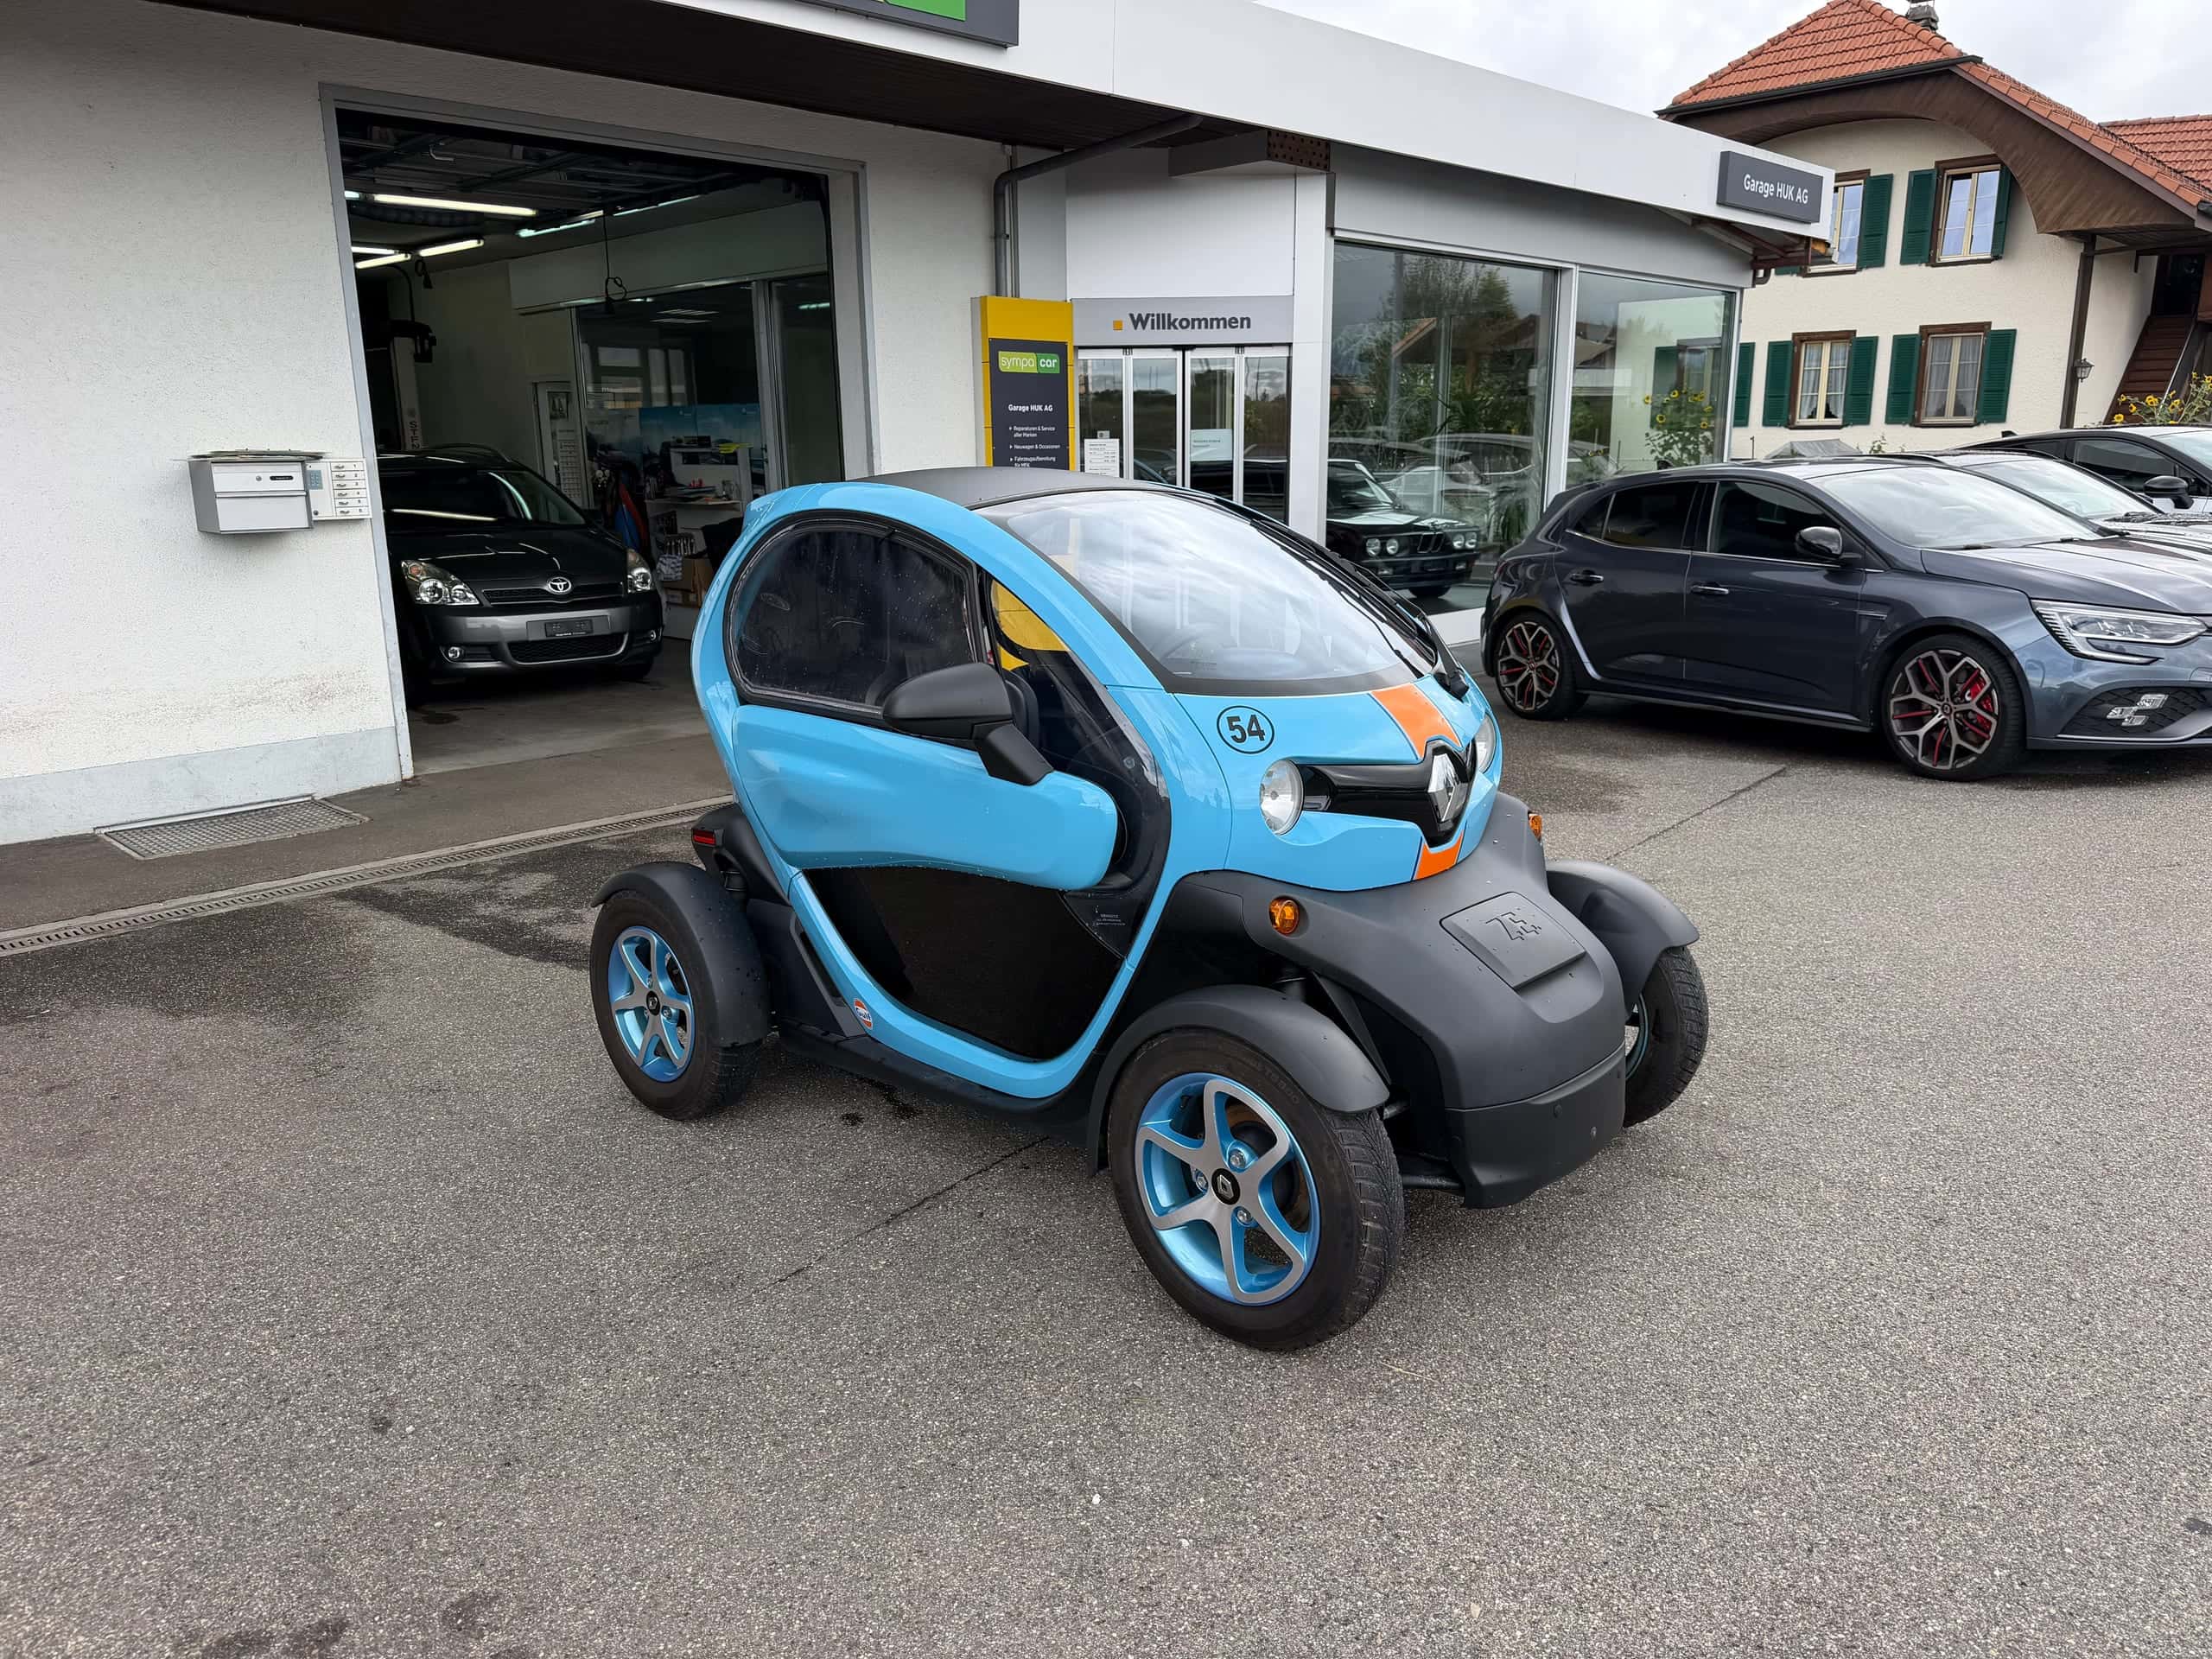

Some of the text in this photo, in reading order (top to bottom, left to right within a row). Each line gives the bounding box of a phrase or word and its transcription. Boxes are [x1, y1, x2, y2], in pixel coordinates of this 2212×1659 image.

[1744, 174, 1808, 204] Garage HUK AG
[1128, 313, 1251, 330] Willkommen
[1008, 404, 1053, 413] Garage HUK AG
[1227, 715, 1265, 743] 54
